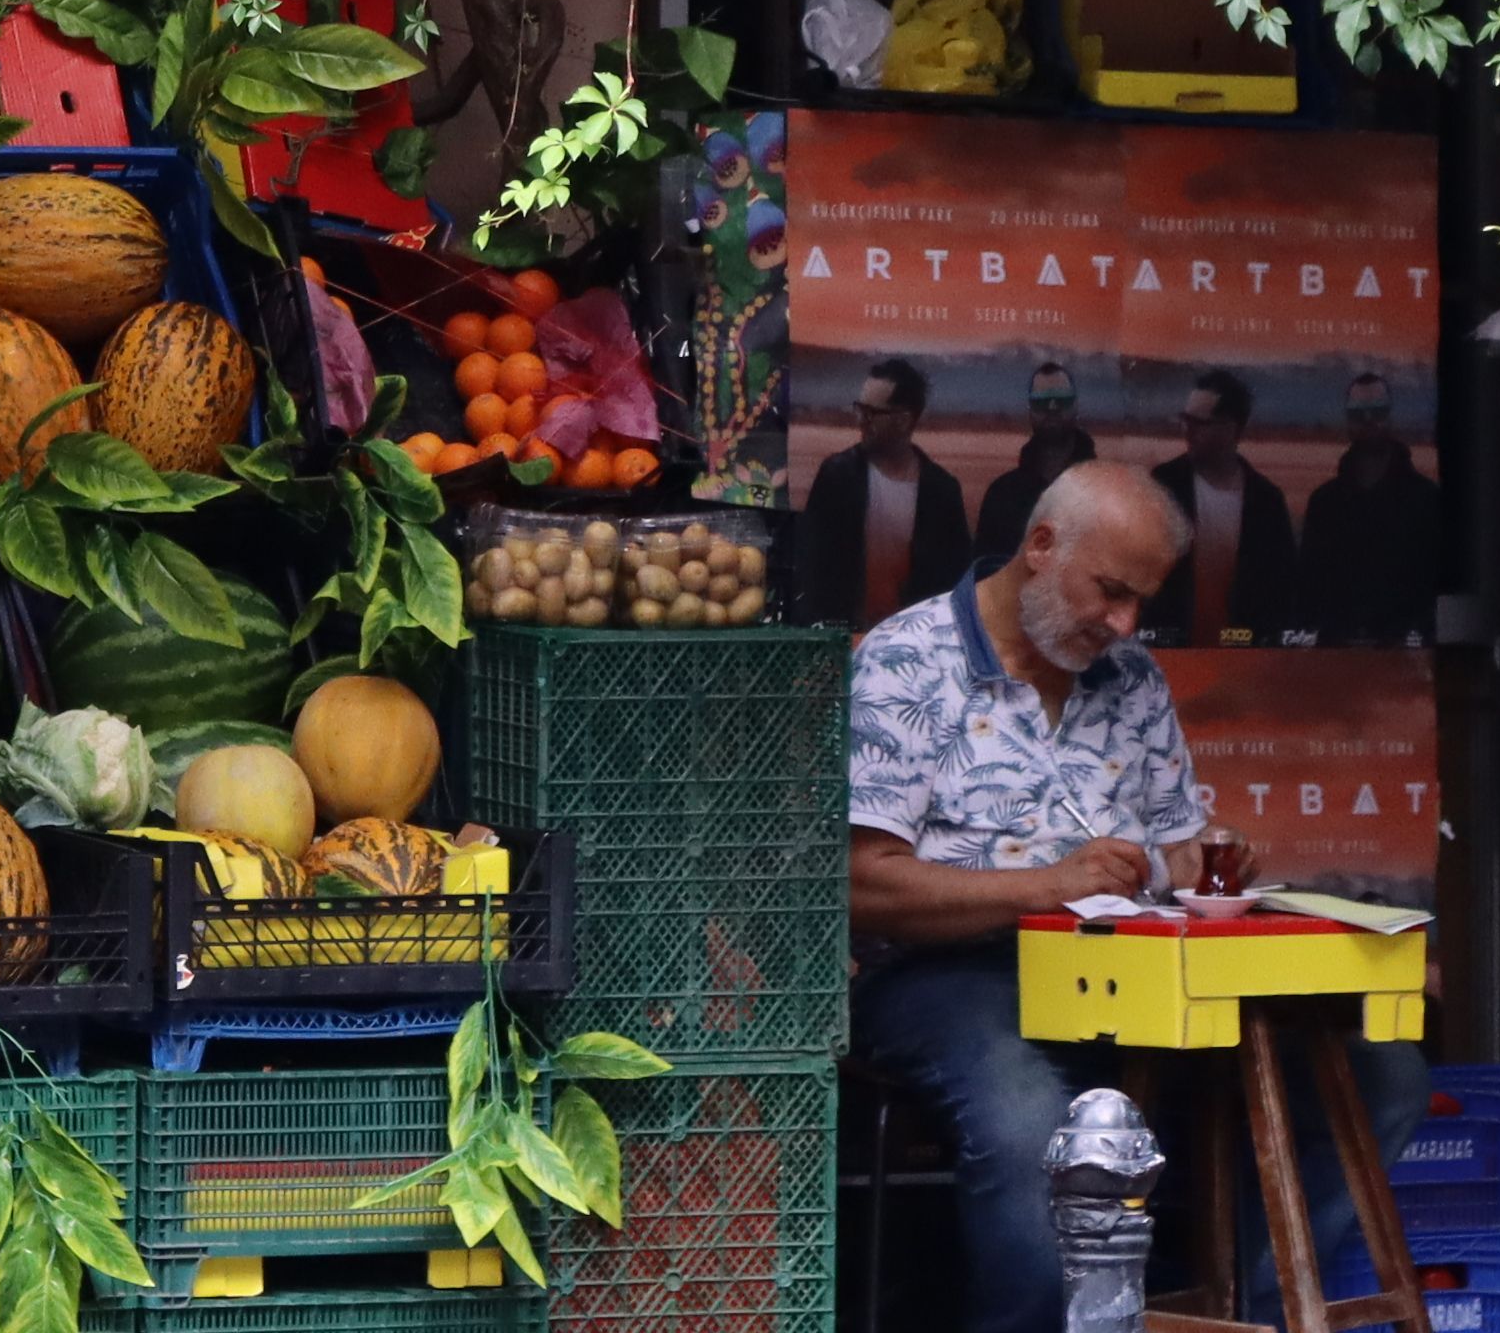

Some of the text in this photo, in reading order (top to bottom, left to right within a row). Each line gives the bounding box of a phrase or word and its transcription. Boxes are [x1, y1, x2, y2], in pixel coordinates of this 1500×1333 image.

[919, 208, 953, 222] PARK
[990, 212, 1006, 226] 20
[802, 245, 1115, 288] ARTBAT
[1131, 258, 1429, 298] ARTBAT
[1195, 782, 1429, 816] RTBAT
